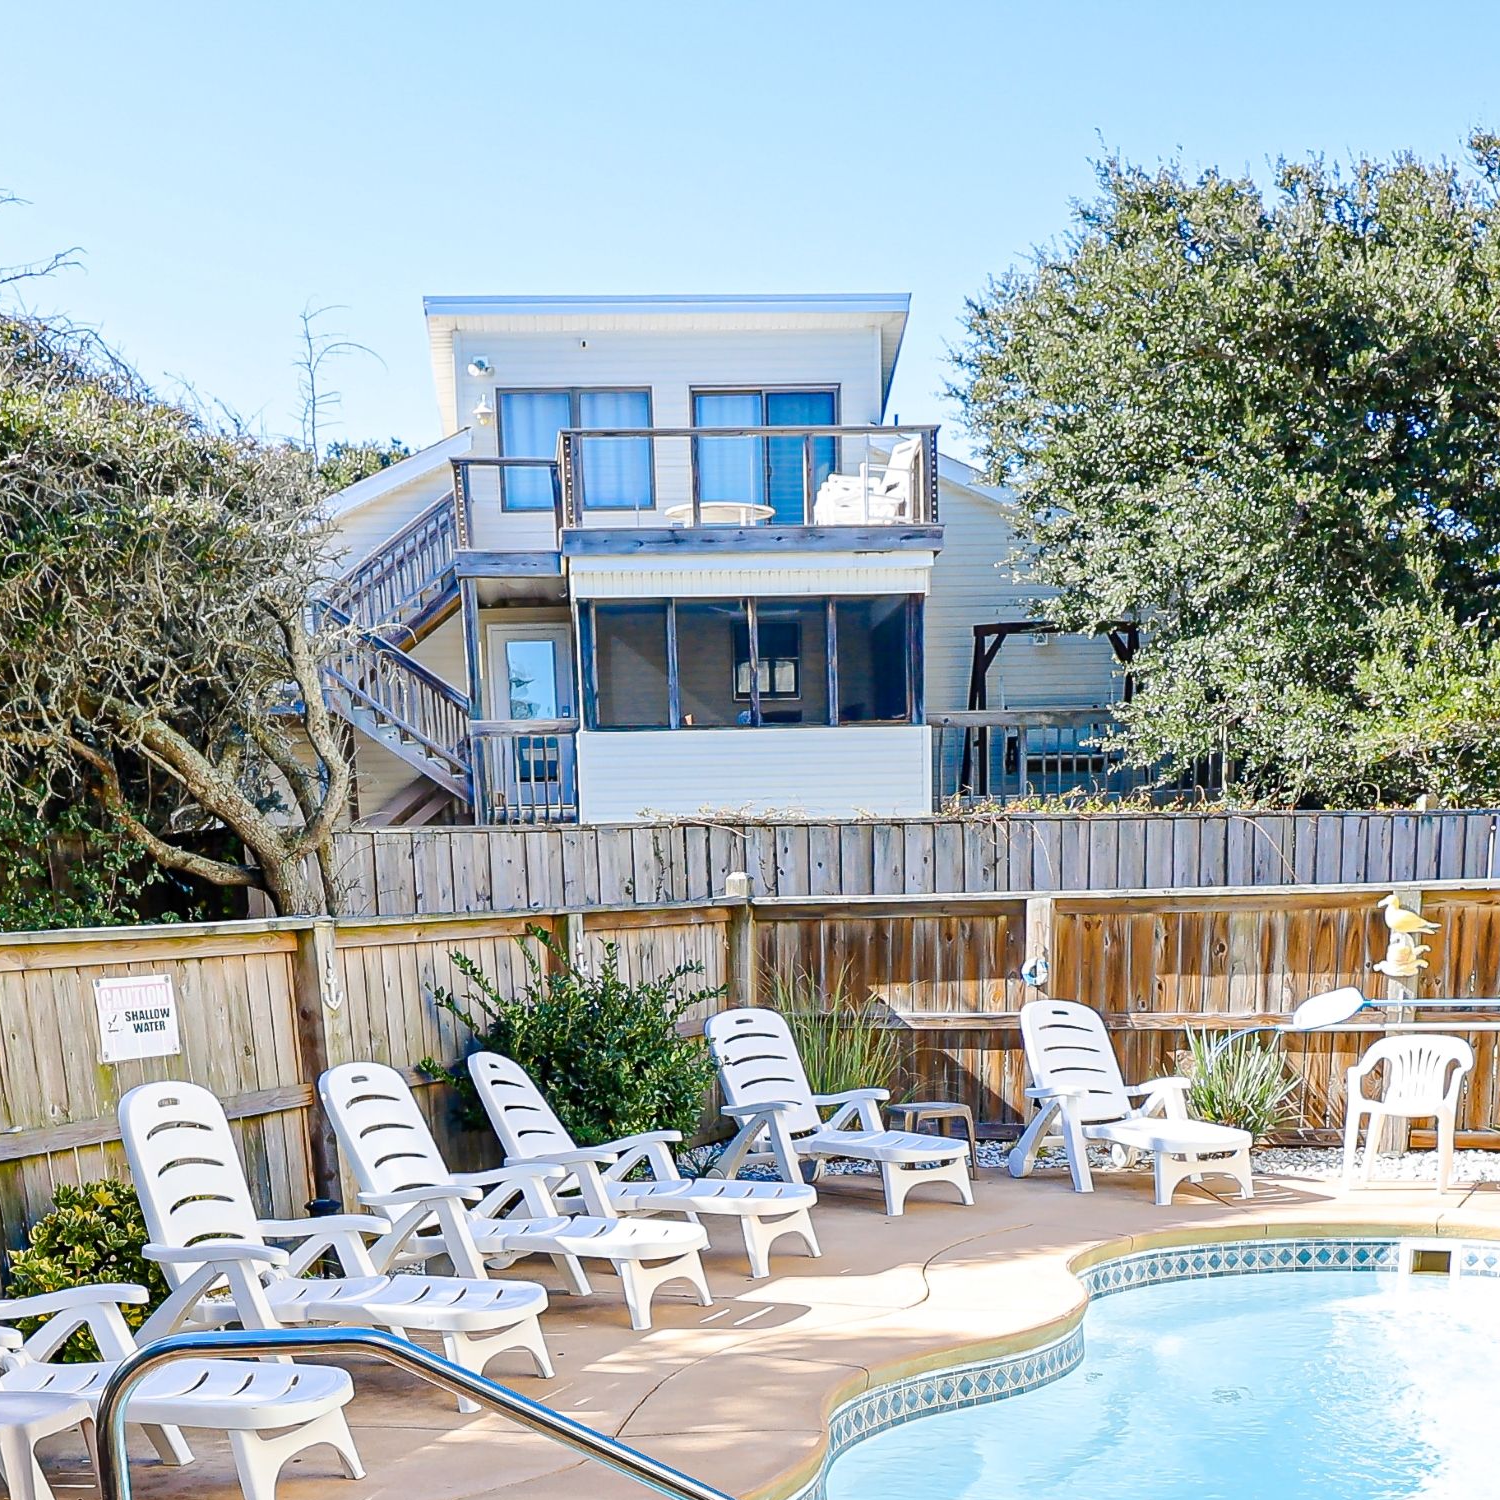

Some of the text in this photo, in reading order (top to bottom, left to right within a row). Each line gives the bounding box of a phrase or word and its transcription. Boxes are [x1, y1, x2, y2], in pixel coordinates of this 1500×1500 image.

[100, 985, 168, 1009] CAUTION
[124, 1008, 170, 1022] SHALLOW
[132, 1020, 166, 1034] WATER
